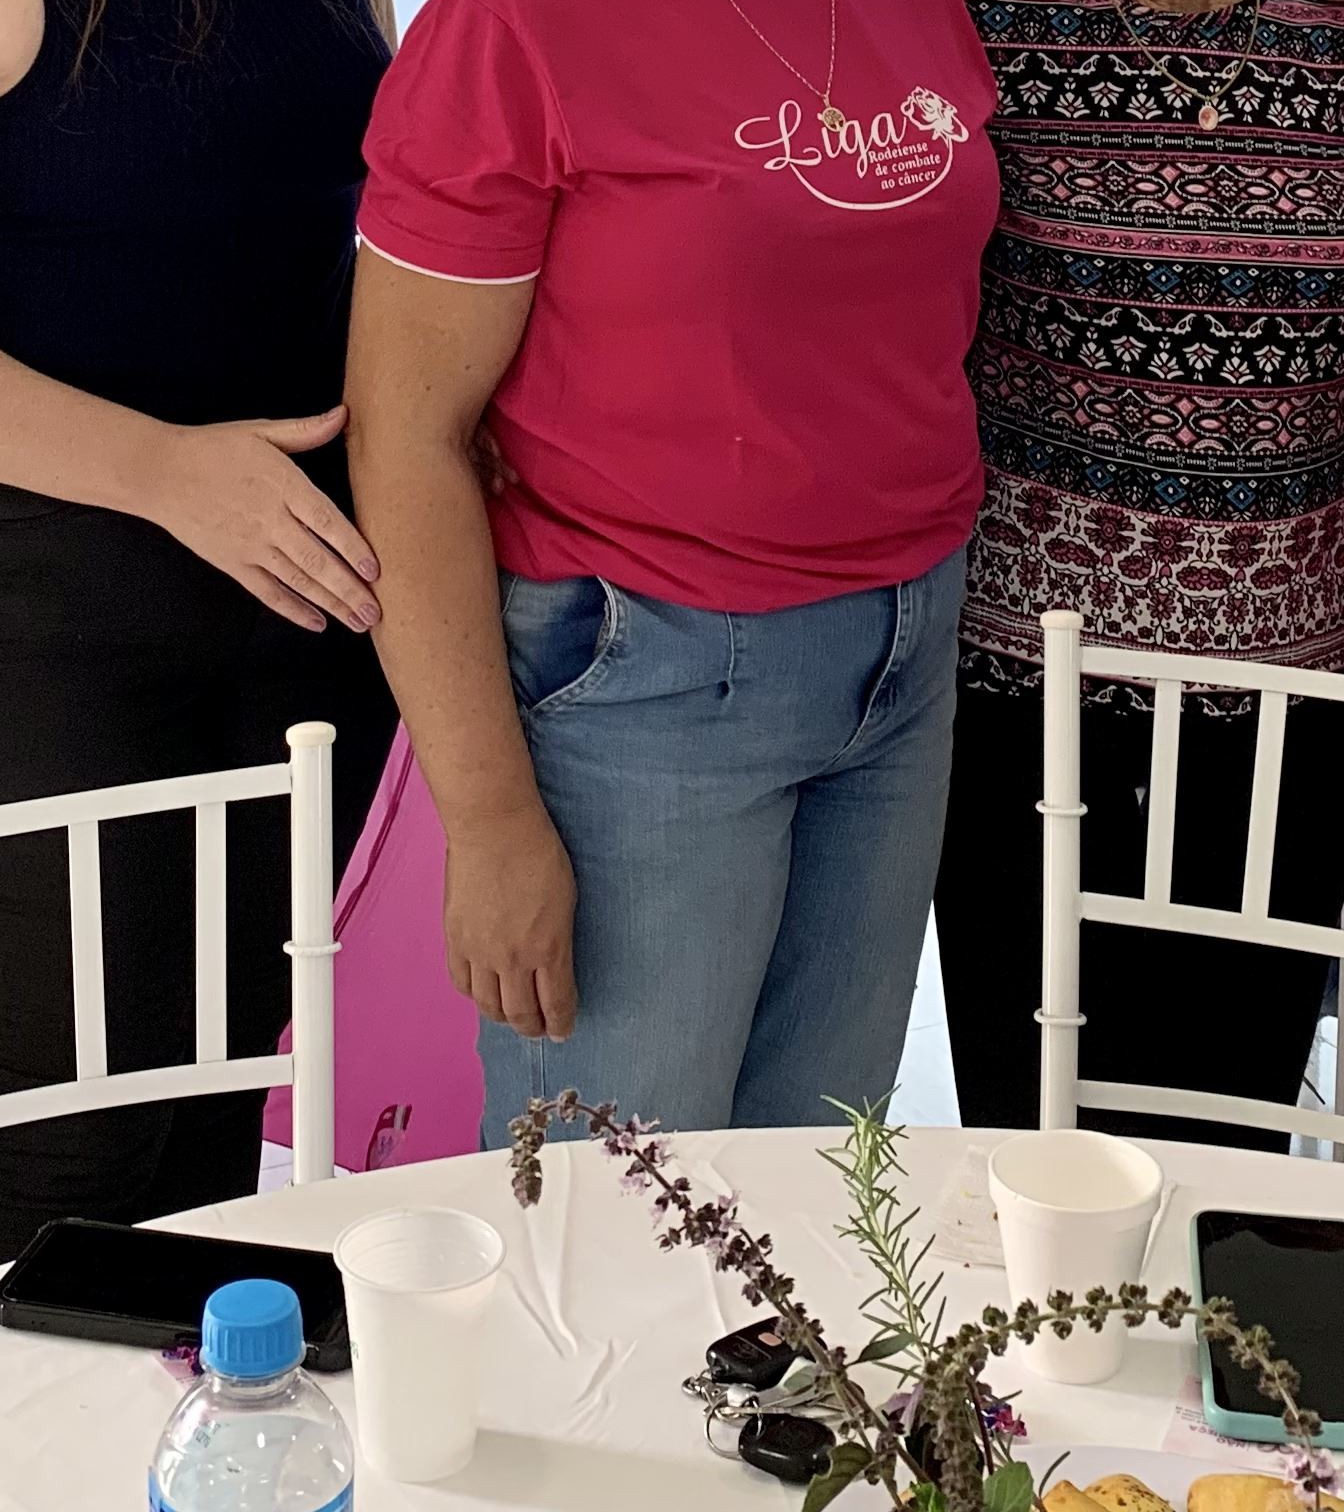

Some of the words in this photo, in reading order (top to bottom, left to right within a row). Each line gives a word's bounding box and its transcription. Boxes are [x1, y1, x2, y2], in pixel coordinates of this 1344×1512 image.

[734, 99, 907, 179] Liga
[868, 140, 929, 164] Rodeiense
[874, 162, 888, 177] de
[891, 153, 941, 174] combate
[880, 178, 896, 190] ao
[897, 169, 936, 188] câncer
